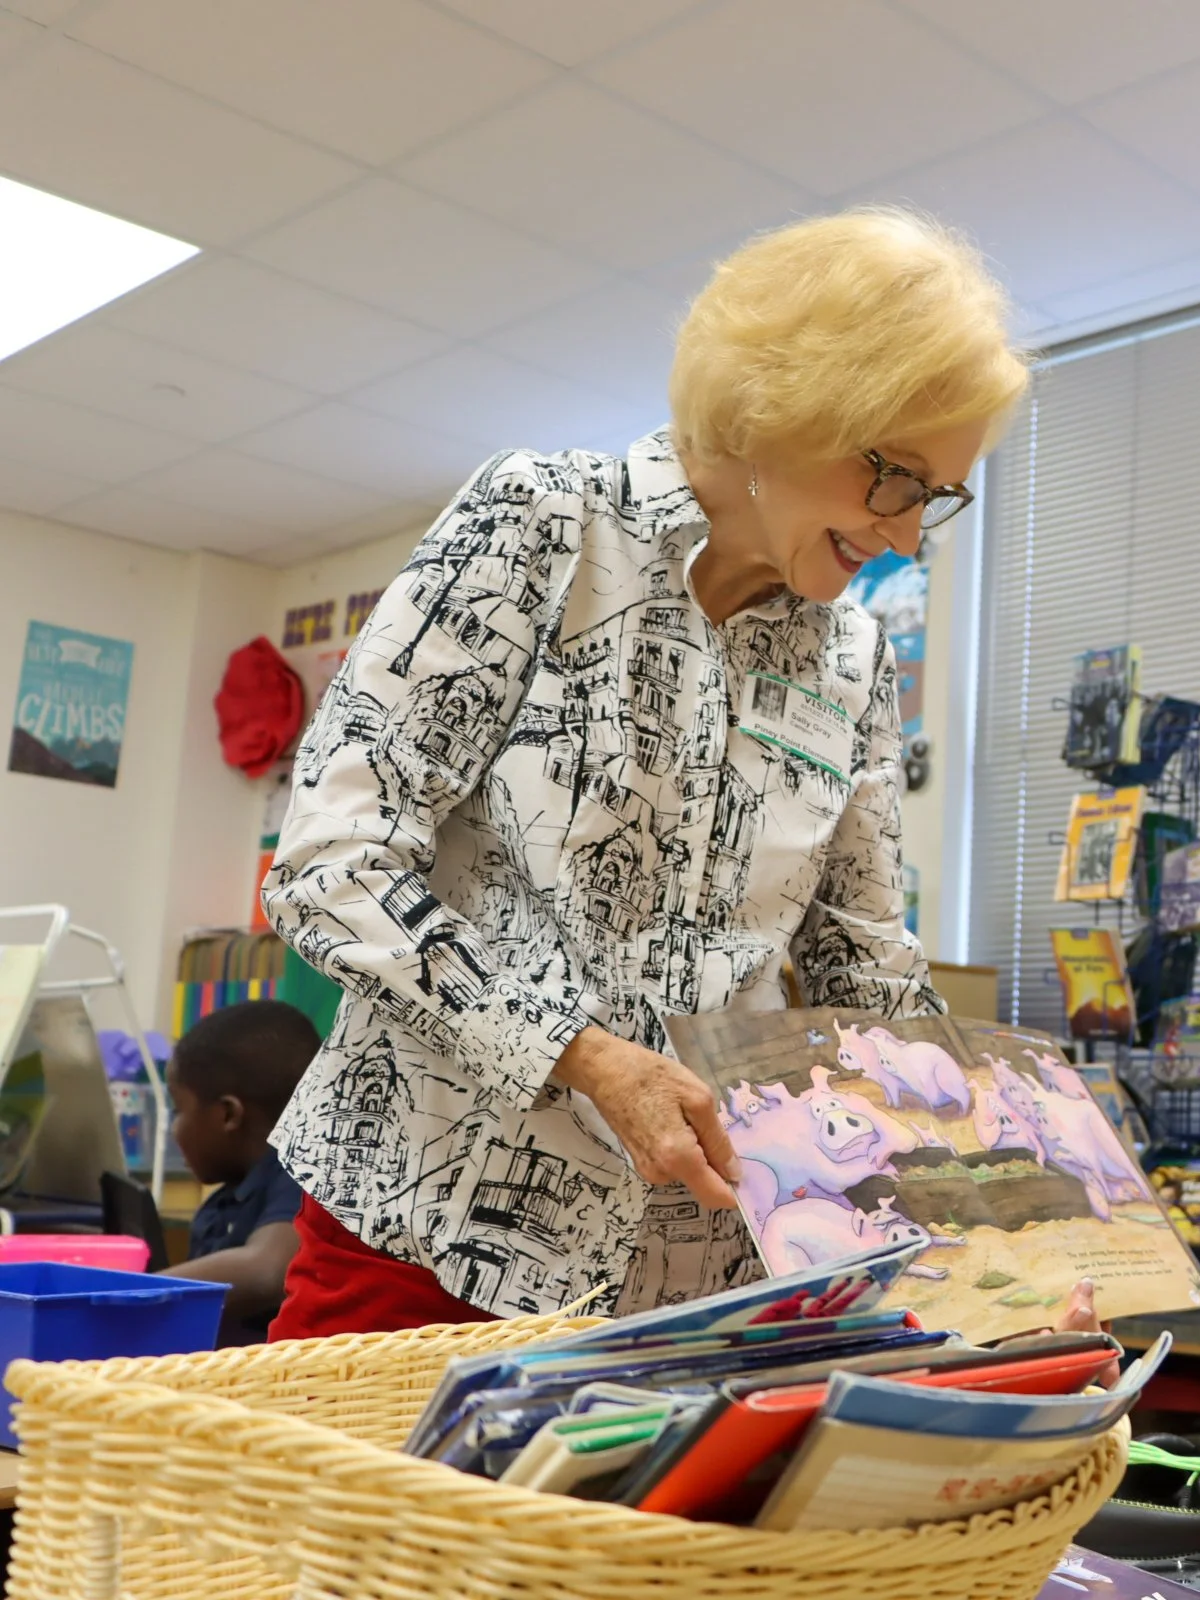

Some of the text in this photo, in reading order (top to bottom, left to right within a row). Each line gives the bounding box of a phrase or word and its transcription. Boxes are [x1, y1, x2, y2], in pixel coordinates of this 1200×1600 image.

[804, 694, 847, 726] VISITOR
[754, 723, 777, 740] Piney
[779, 734, 801, 749] Point
[790, 711, 812, 729] Sally
[813, 723, 832, 740] Gray
